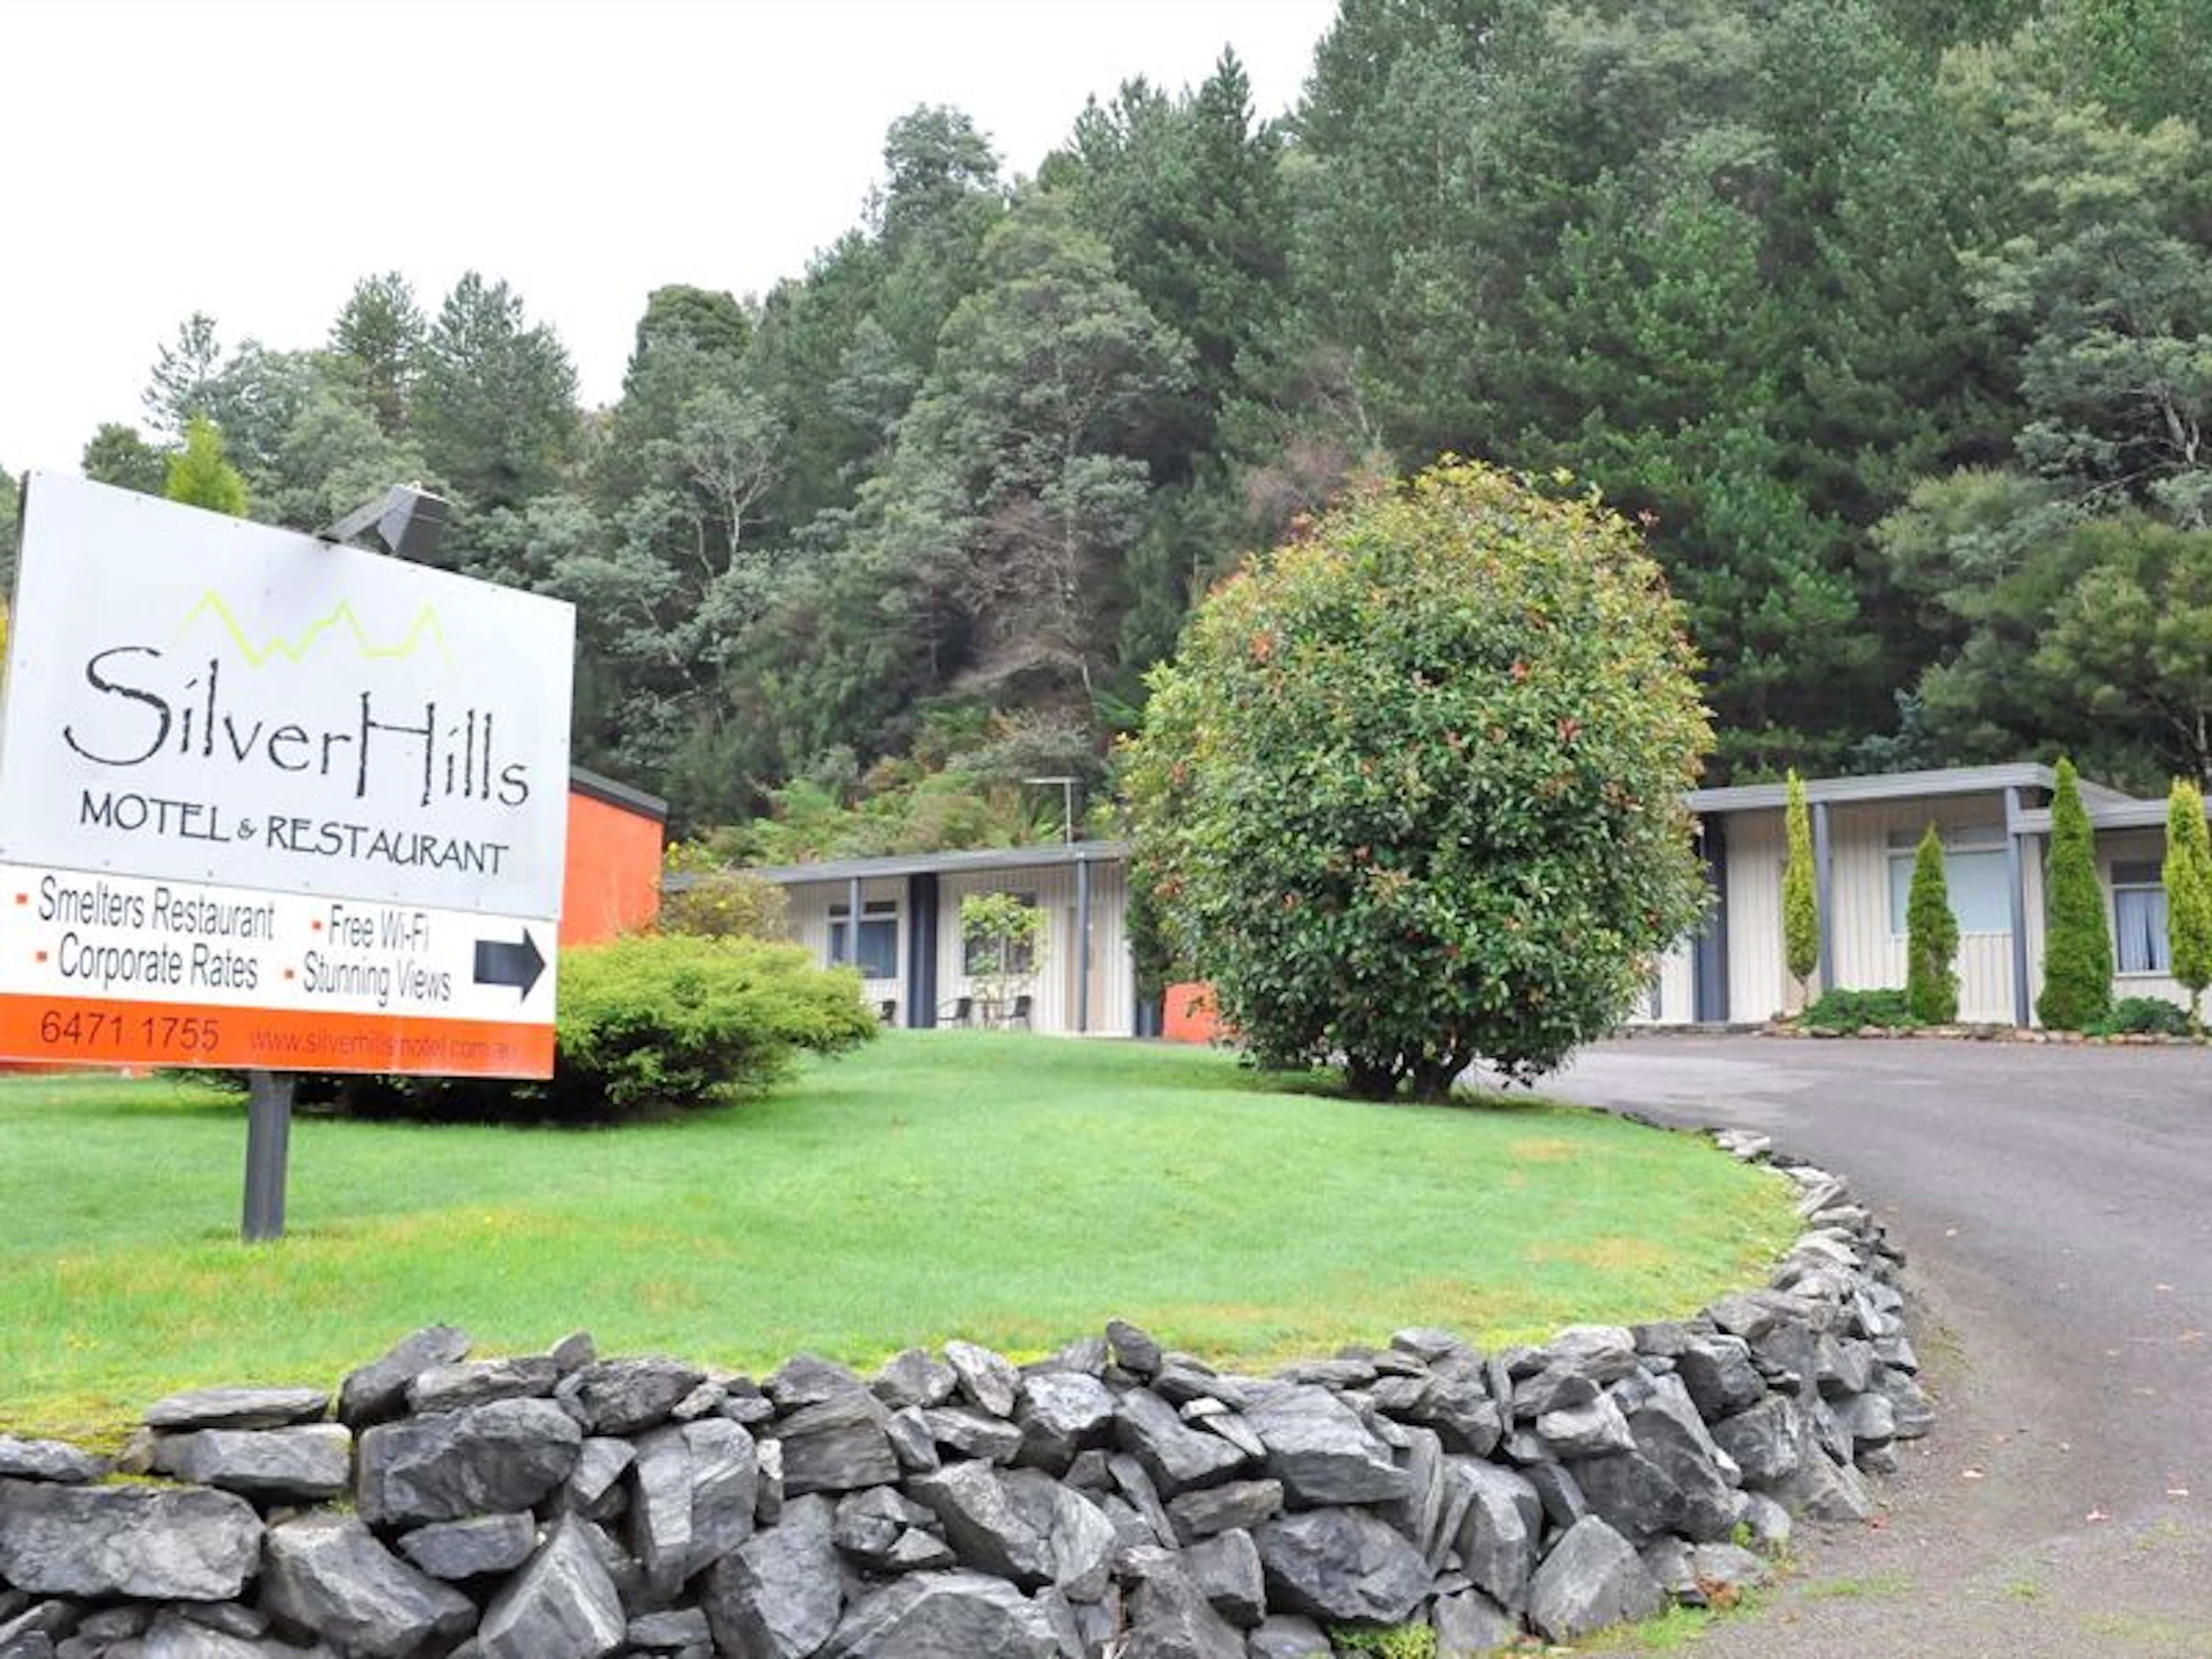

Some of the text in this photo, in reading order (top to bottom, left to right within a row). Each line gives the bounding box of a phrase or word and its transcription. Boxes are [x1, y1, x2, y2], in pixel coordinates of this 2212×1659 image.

[79, 790, 509, 874] MOTEL & RESTAURANT
[39, 875, 275, 940] Smelters Restaurant
[329, 904, 429, 952] Free Wi-Fi
[59, 931, 259, 990] Corporate Rates
[304, 950, 451, 1007] Stunning Views
[41, 1010, 219, 1051] 6471 1755
